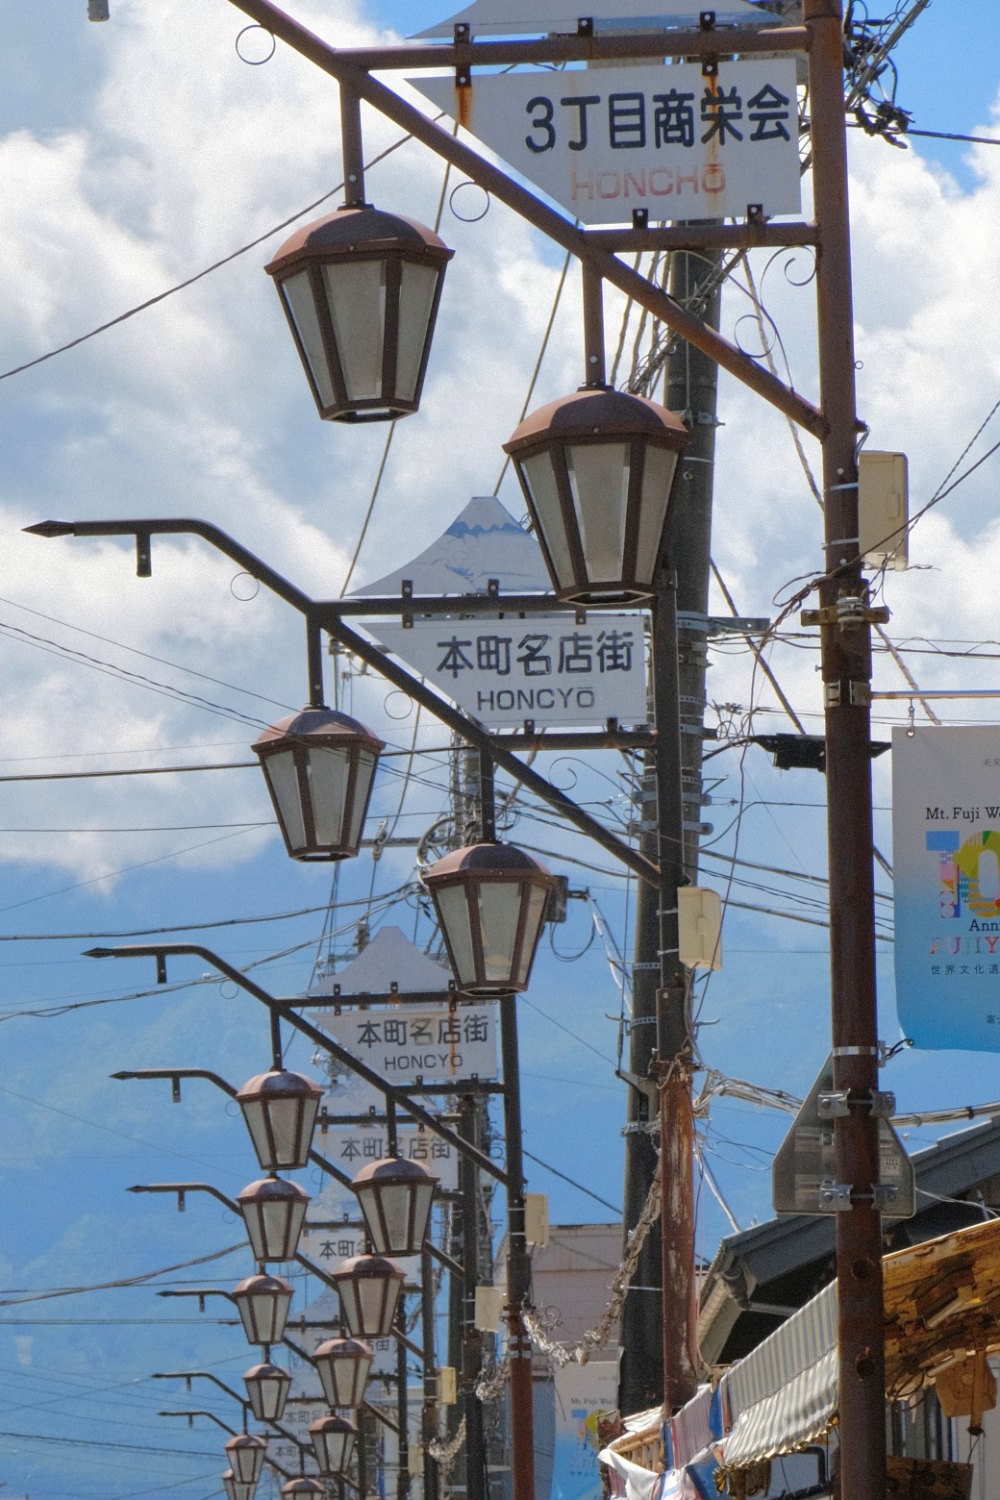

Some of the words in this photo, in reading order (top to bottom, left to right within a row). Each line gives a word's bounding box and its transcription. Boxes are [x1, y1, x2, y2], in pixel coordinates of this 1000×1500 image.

[525, 83, 791, 153] 3丁目商栄会
[436, 630, 634, 678] 本町名店街
[925, 807, 949, 820] Mt.
[953, 807, 980, 823] Fuji
[357, 1014, 489, 1048] 本町名店街
